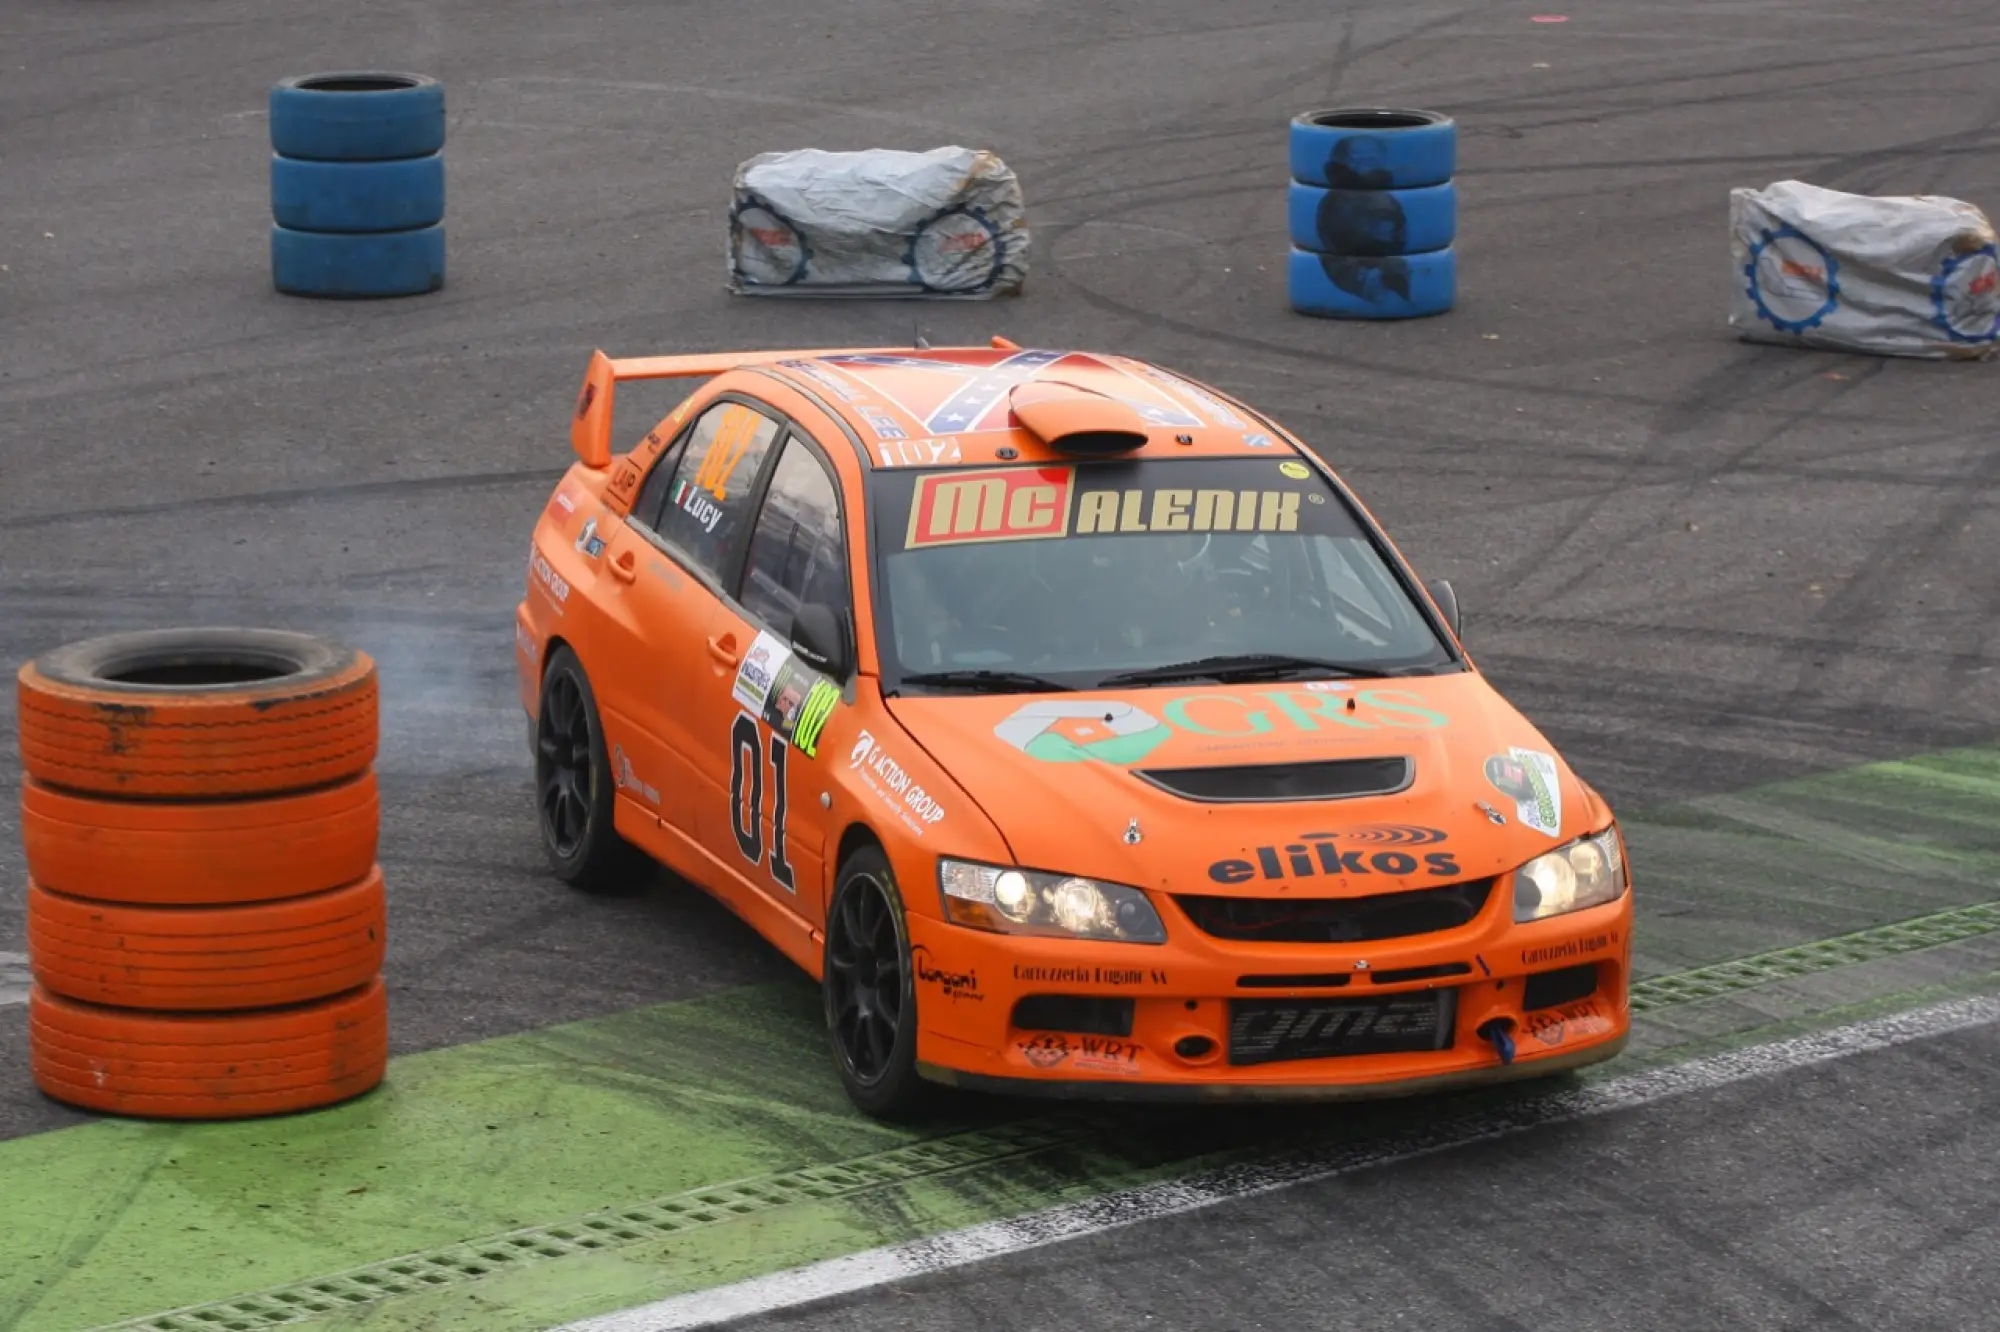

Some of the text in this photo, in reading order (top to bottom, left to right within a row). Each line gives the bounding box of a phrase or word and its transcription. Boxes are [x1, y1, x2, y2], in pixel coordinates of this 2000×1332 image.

[683, 485, 724, 534] Lucy
[1163, 689, 1450, 738] GRS
[730, 710, 797, 897] 01
[874, 754, 912, 796] ACTION
[904, 786, 945, 824] GROUP
[1208, 841, 1461, 885] elikos
